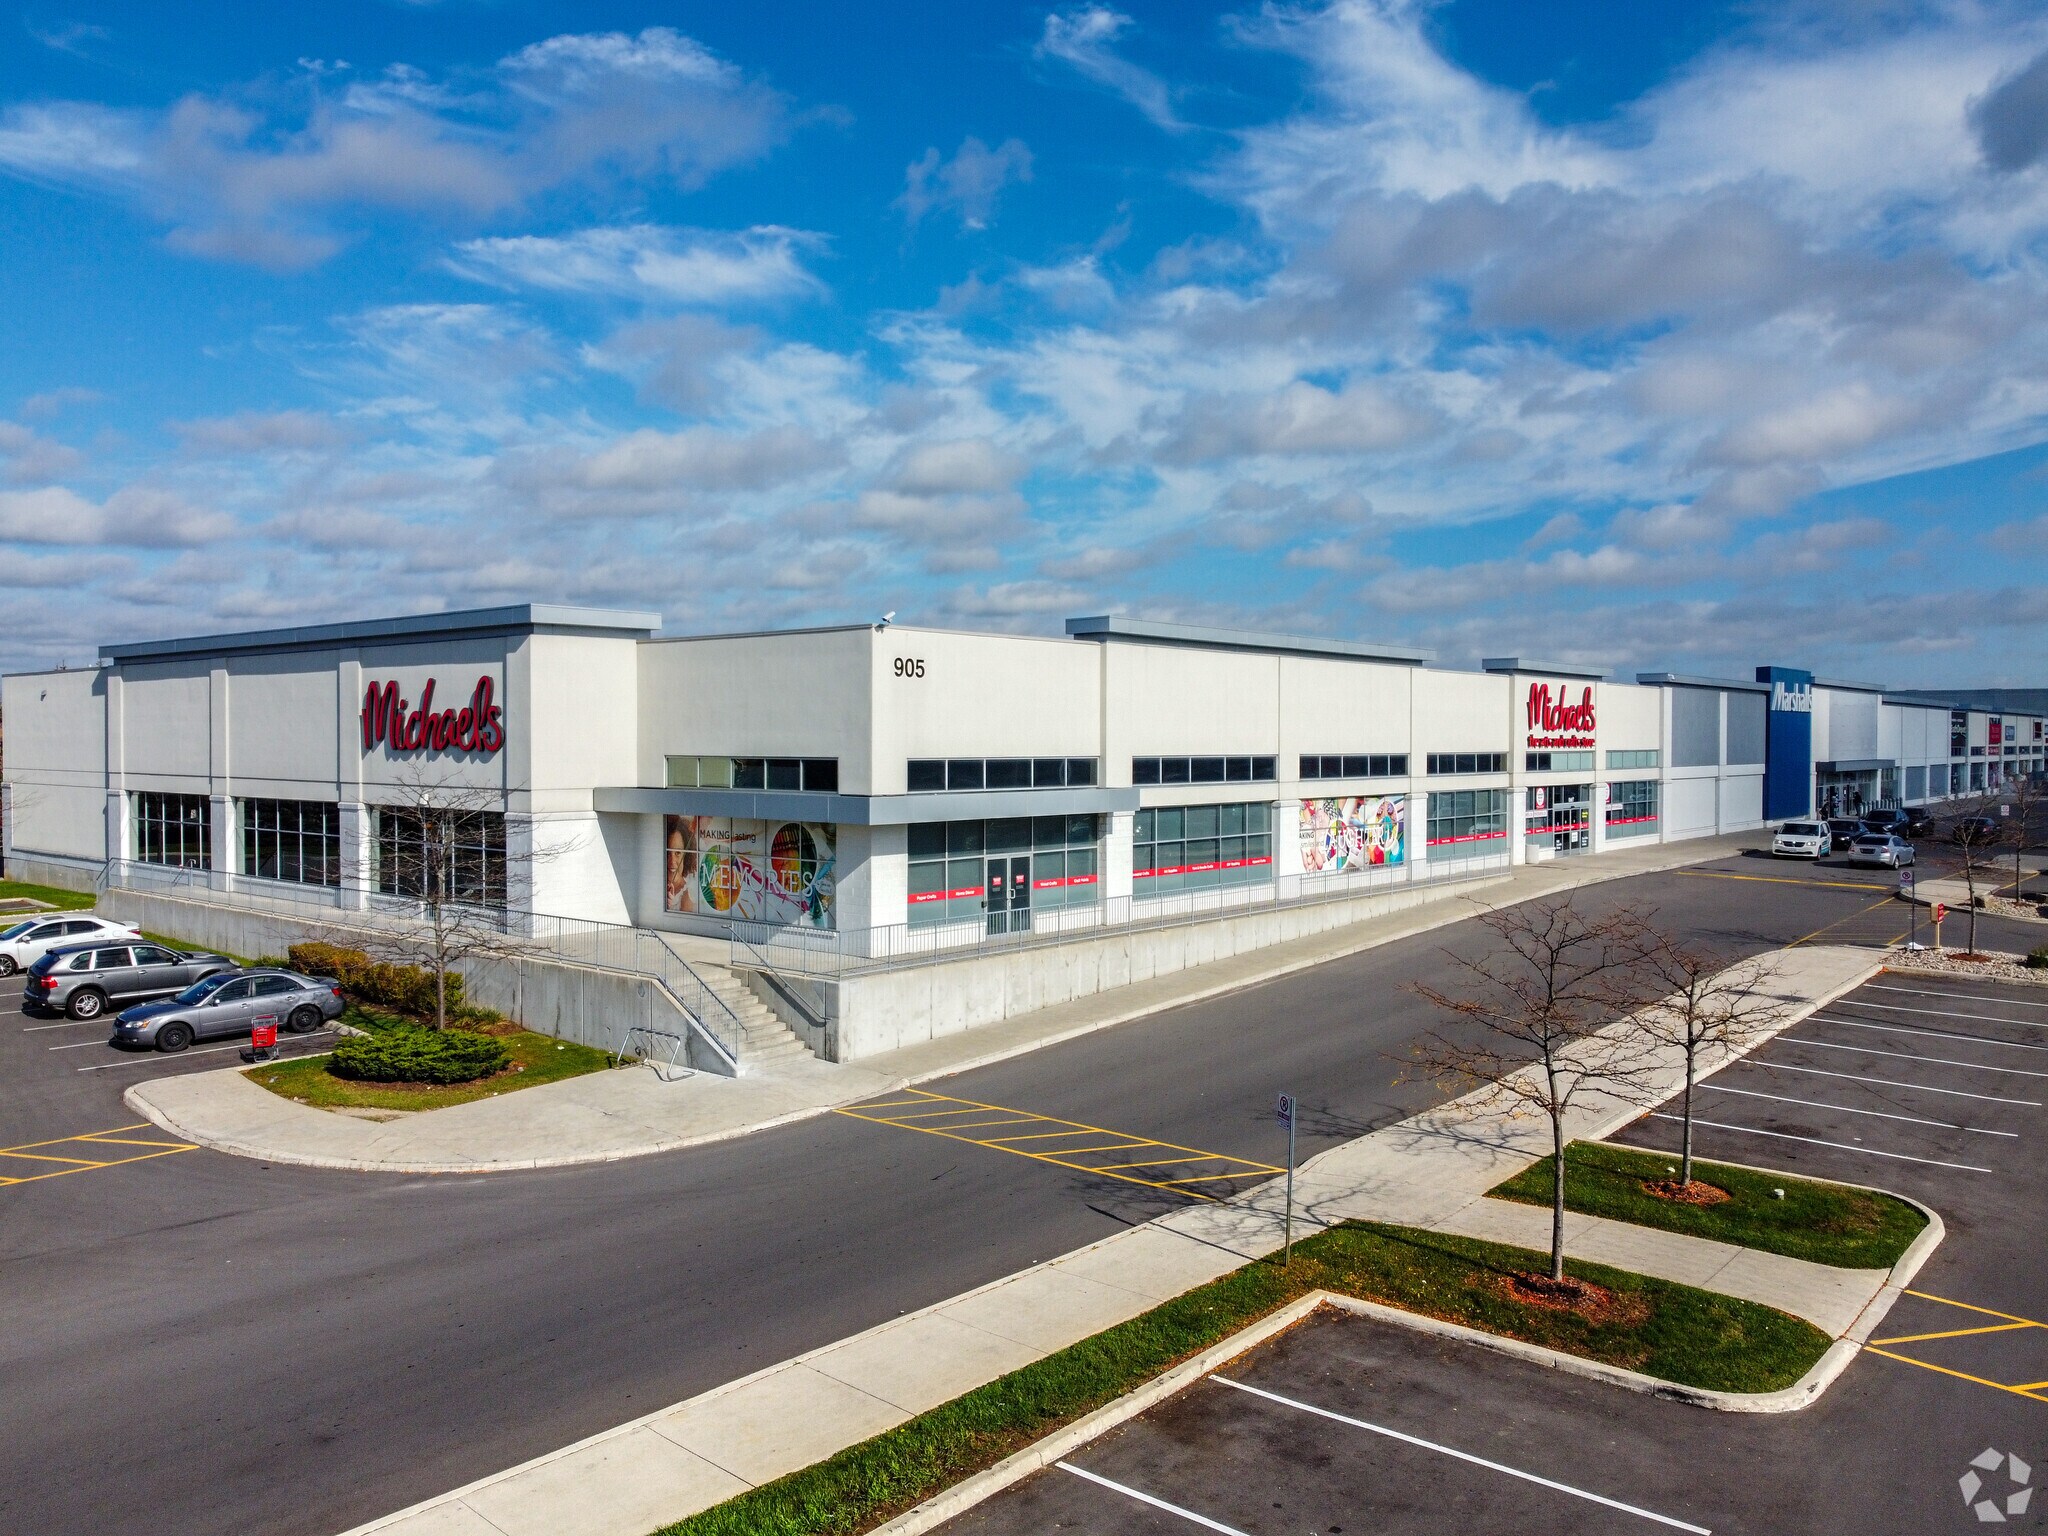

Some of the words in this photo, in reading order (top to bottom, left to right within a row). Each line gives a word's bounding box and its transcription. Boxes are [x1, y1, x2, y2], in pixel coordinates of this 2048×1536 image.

[894, 657, 925, 679] 905
[1526, 683, 1596, 732] Michaels
[1771, 682, 1812, 712] Marshalls
[361, 675, 506, 752] Michaels
[699, 829, 730, 840] MAKING
[732, 831, 757, 844] lasting
[700, 863, 814, 898] MEMORIES
